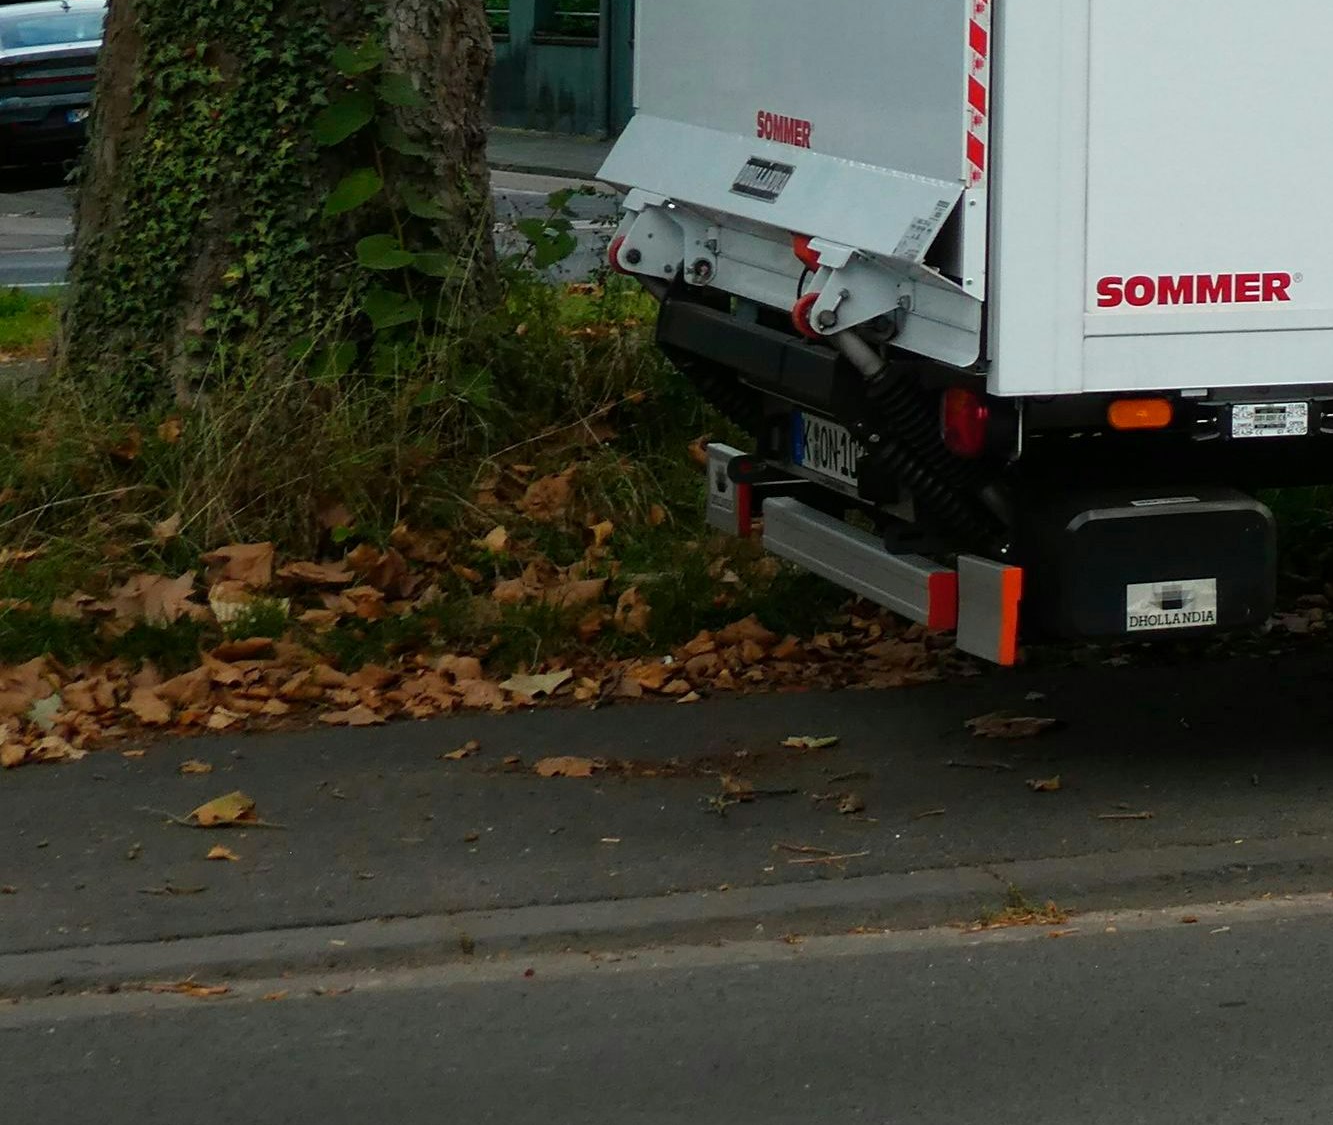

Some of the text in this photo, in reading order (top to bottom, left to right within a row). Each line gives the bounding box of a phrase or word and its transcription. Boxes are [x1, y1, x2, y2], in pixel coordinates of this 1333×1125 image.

[757, 110, 811, 149] SOMMER
[1097, 273, 1291, 307] SOMMER
[1129, 610, 1214, 628] DHOLLANDIA
